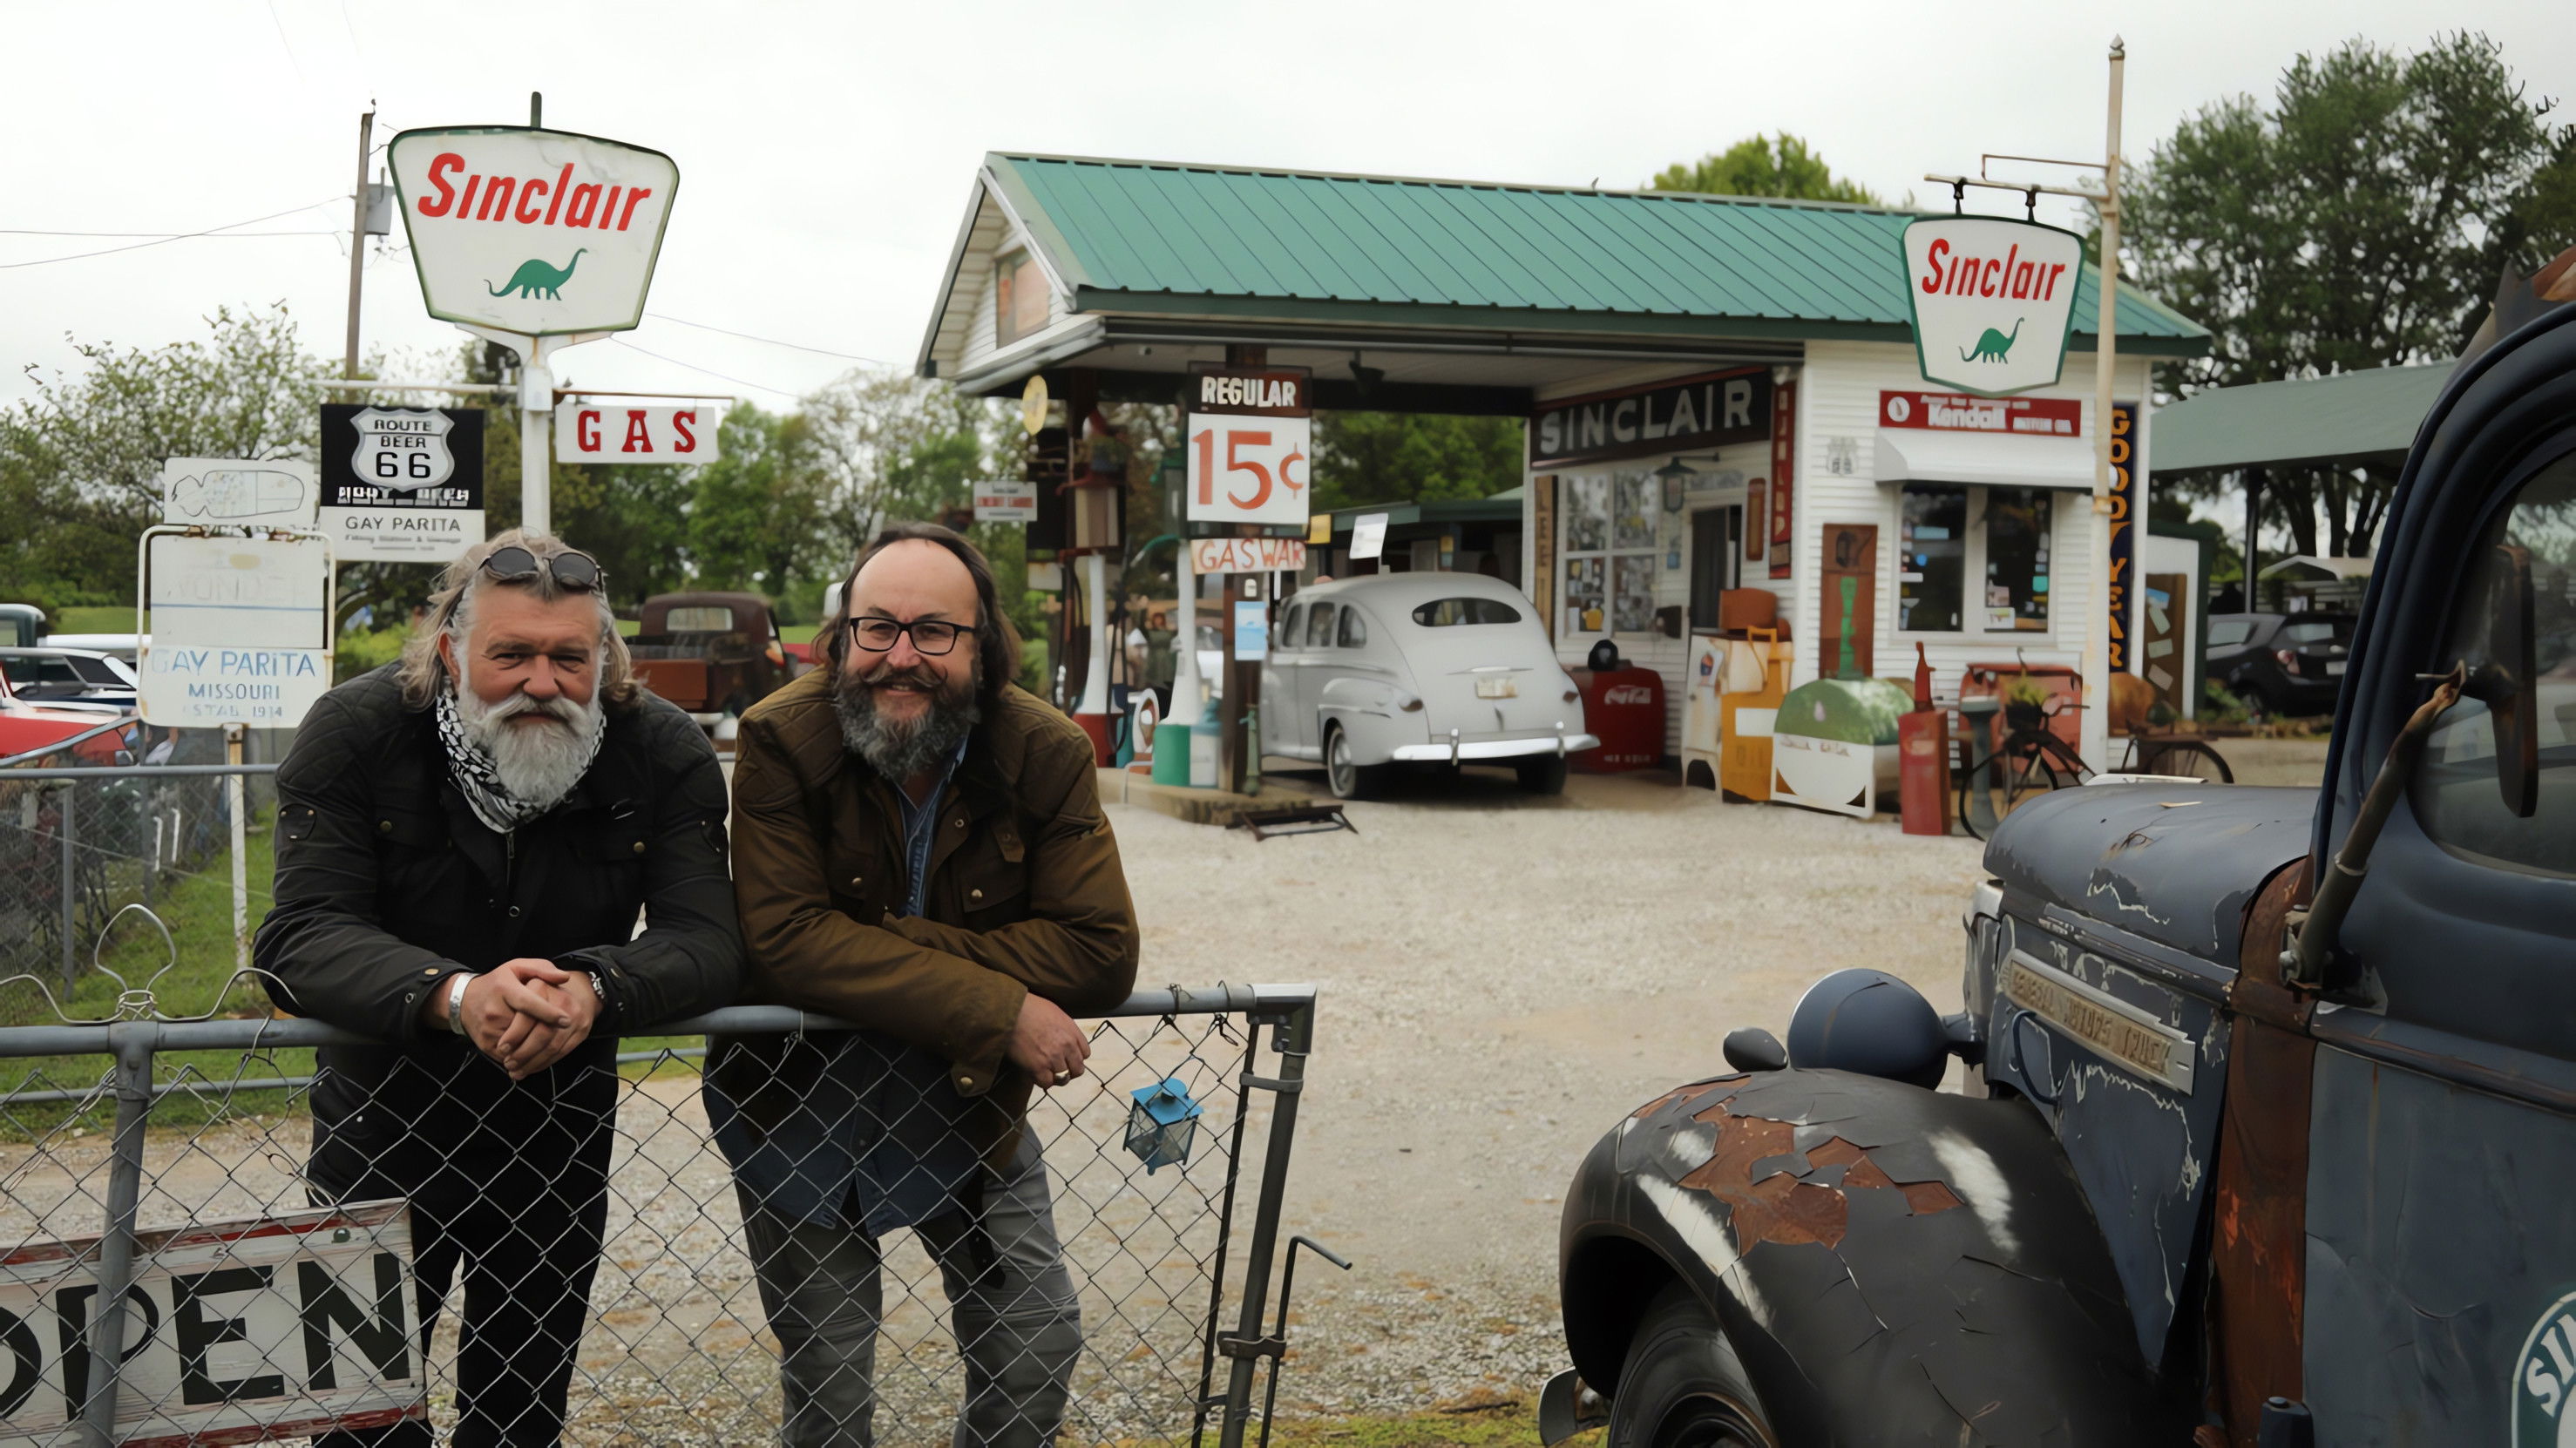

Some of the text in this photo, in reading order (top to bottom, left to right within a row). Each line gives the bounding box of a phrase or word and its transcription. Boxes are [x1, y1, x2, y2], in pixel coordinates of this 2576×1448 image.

[417, 152, 652, 231] Sinclair
[1922, 238, 2065, 301] Sinclair
[1201, 376, 1297, 408] REGULAR
[374, 419, 432, 431] ROUTE
[577, 409, 695, 453] GAS
[1539, 378, 1752, 455] SINCLAIR
[380, 436, 426, 448] BEER
[376, 451, 431, 478] 66
[1190, 429, 1305, 511] 15¢
[345, 517, 461, 532] GAY PARITA
[1198, 538, 1256, 571] GAS
[151, 648, 209, 676] GAY
[188, 683, 280, 700] MISSOURI
